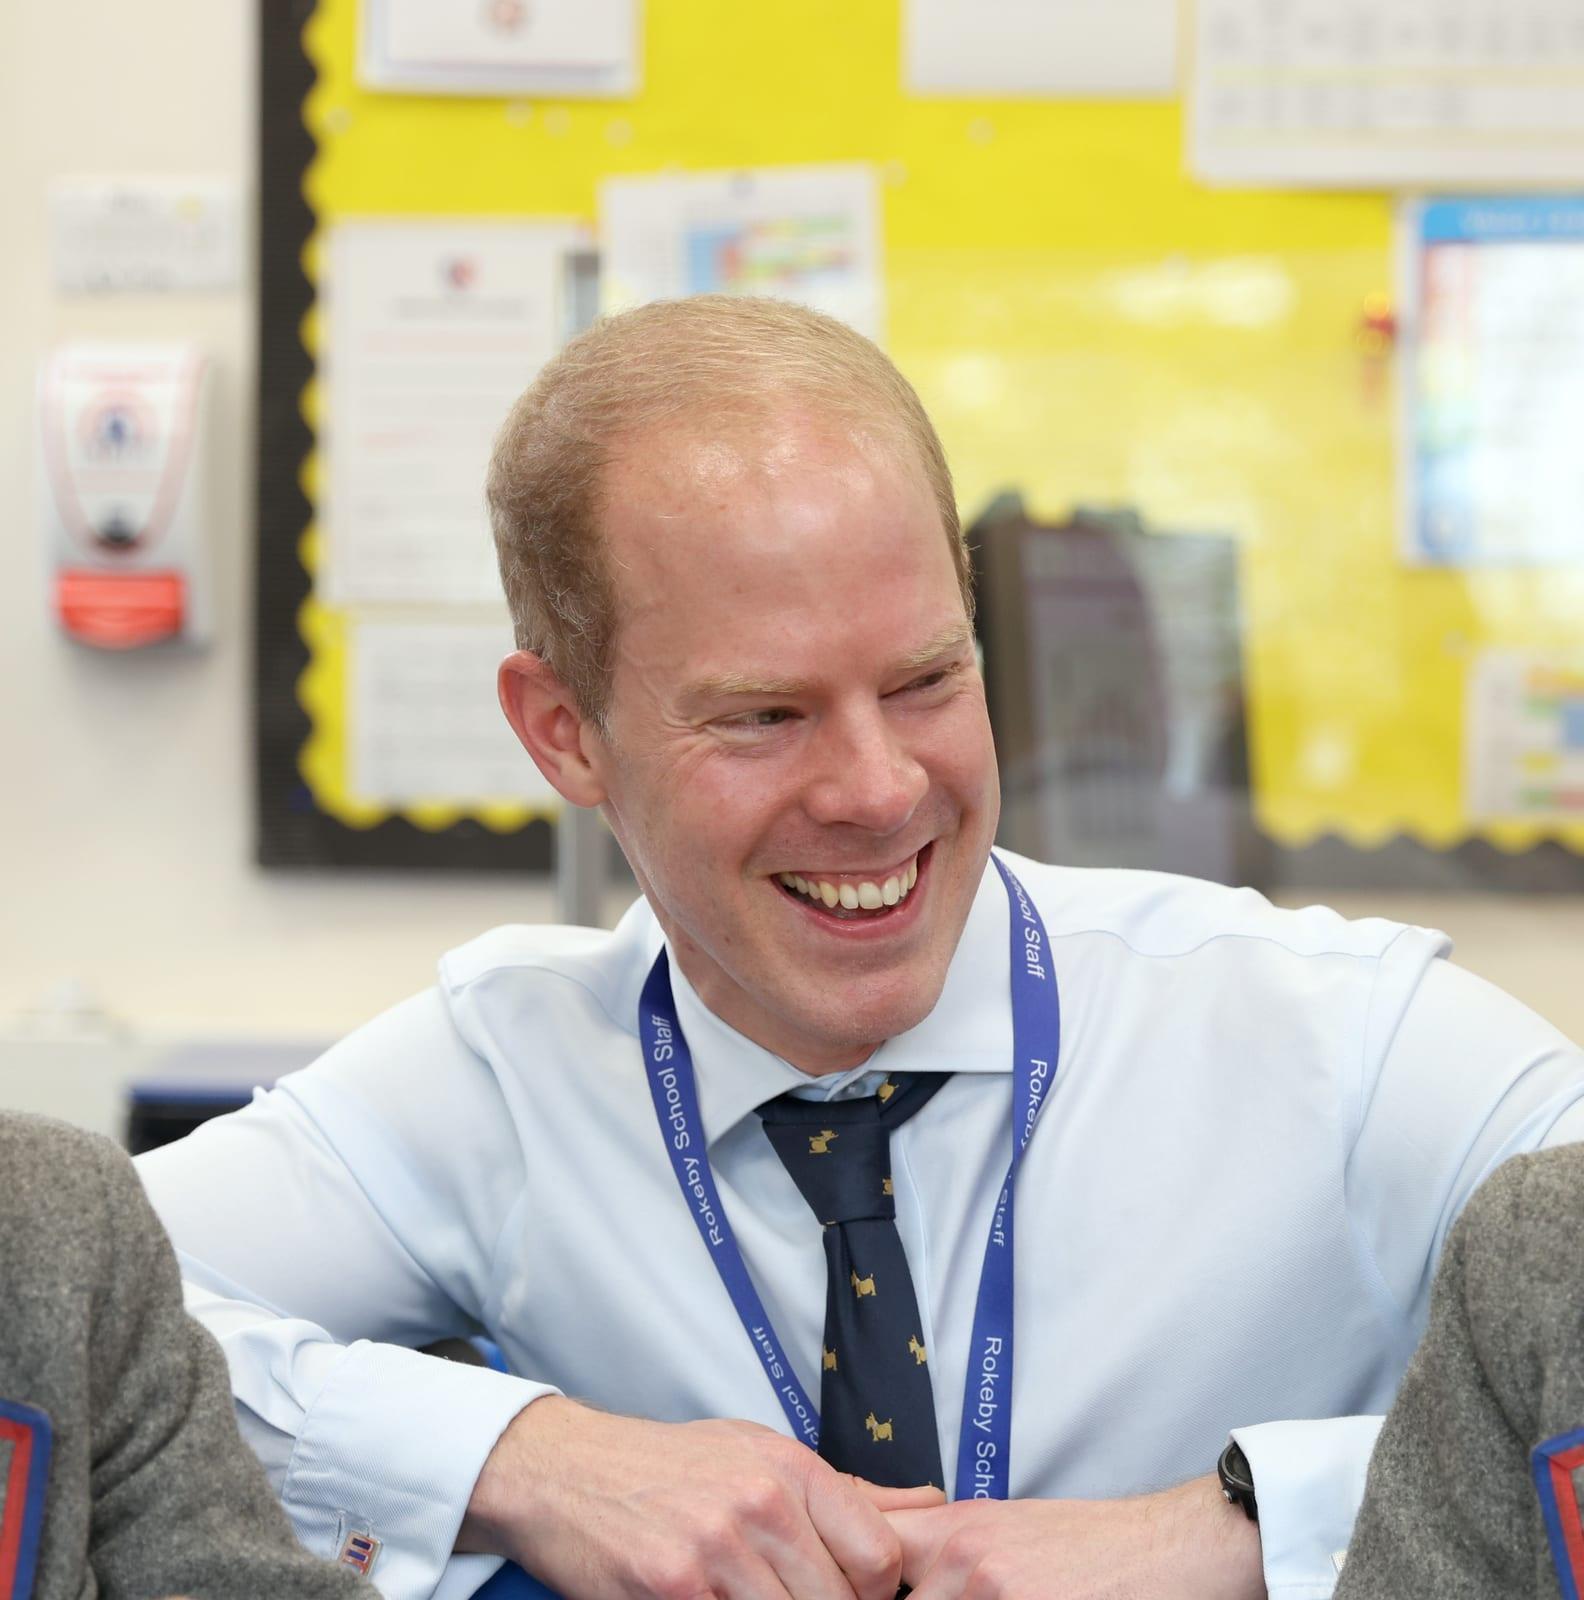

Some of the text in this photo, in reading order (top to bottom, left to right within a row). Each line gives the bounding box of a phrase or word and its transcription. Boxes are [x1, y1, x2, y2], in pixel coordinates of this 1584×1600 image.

[1024, 927, 1046, 980] Staff
[651, 1014, 724, 1246] Rokeby School Staff
[752, 1326, 820, 1448] chool Staff
[972, 1336, 1003, 1433] Rokeby
